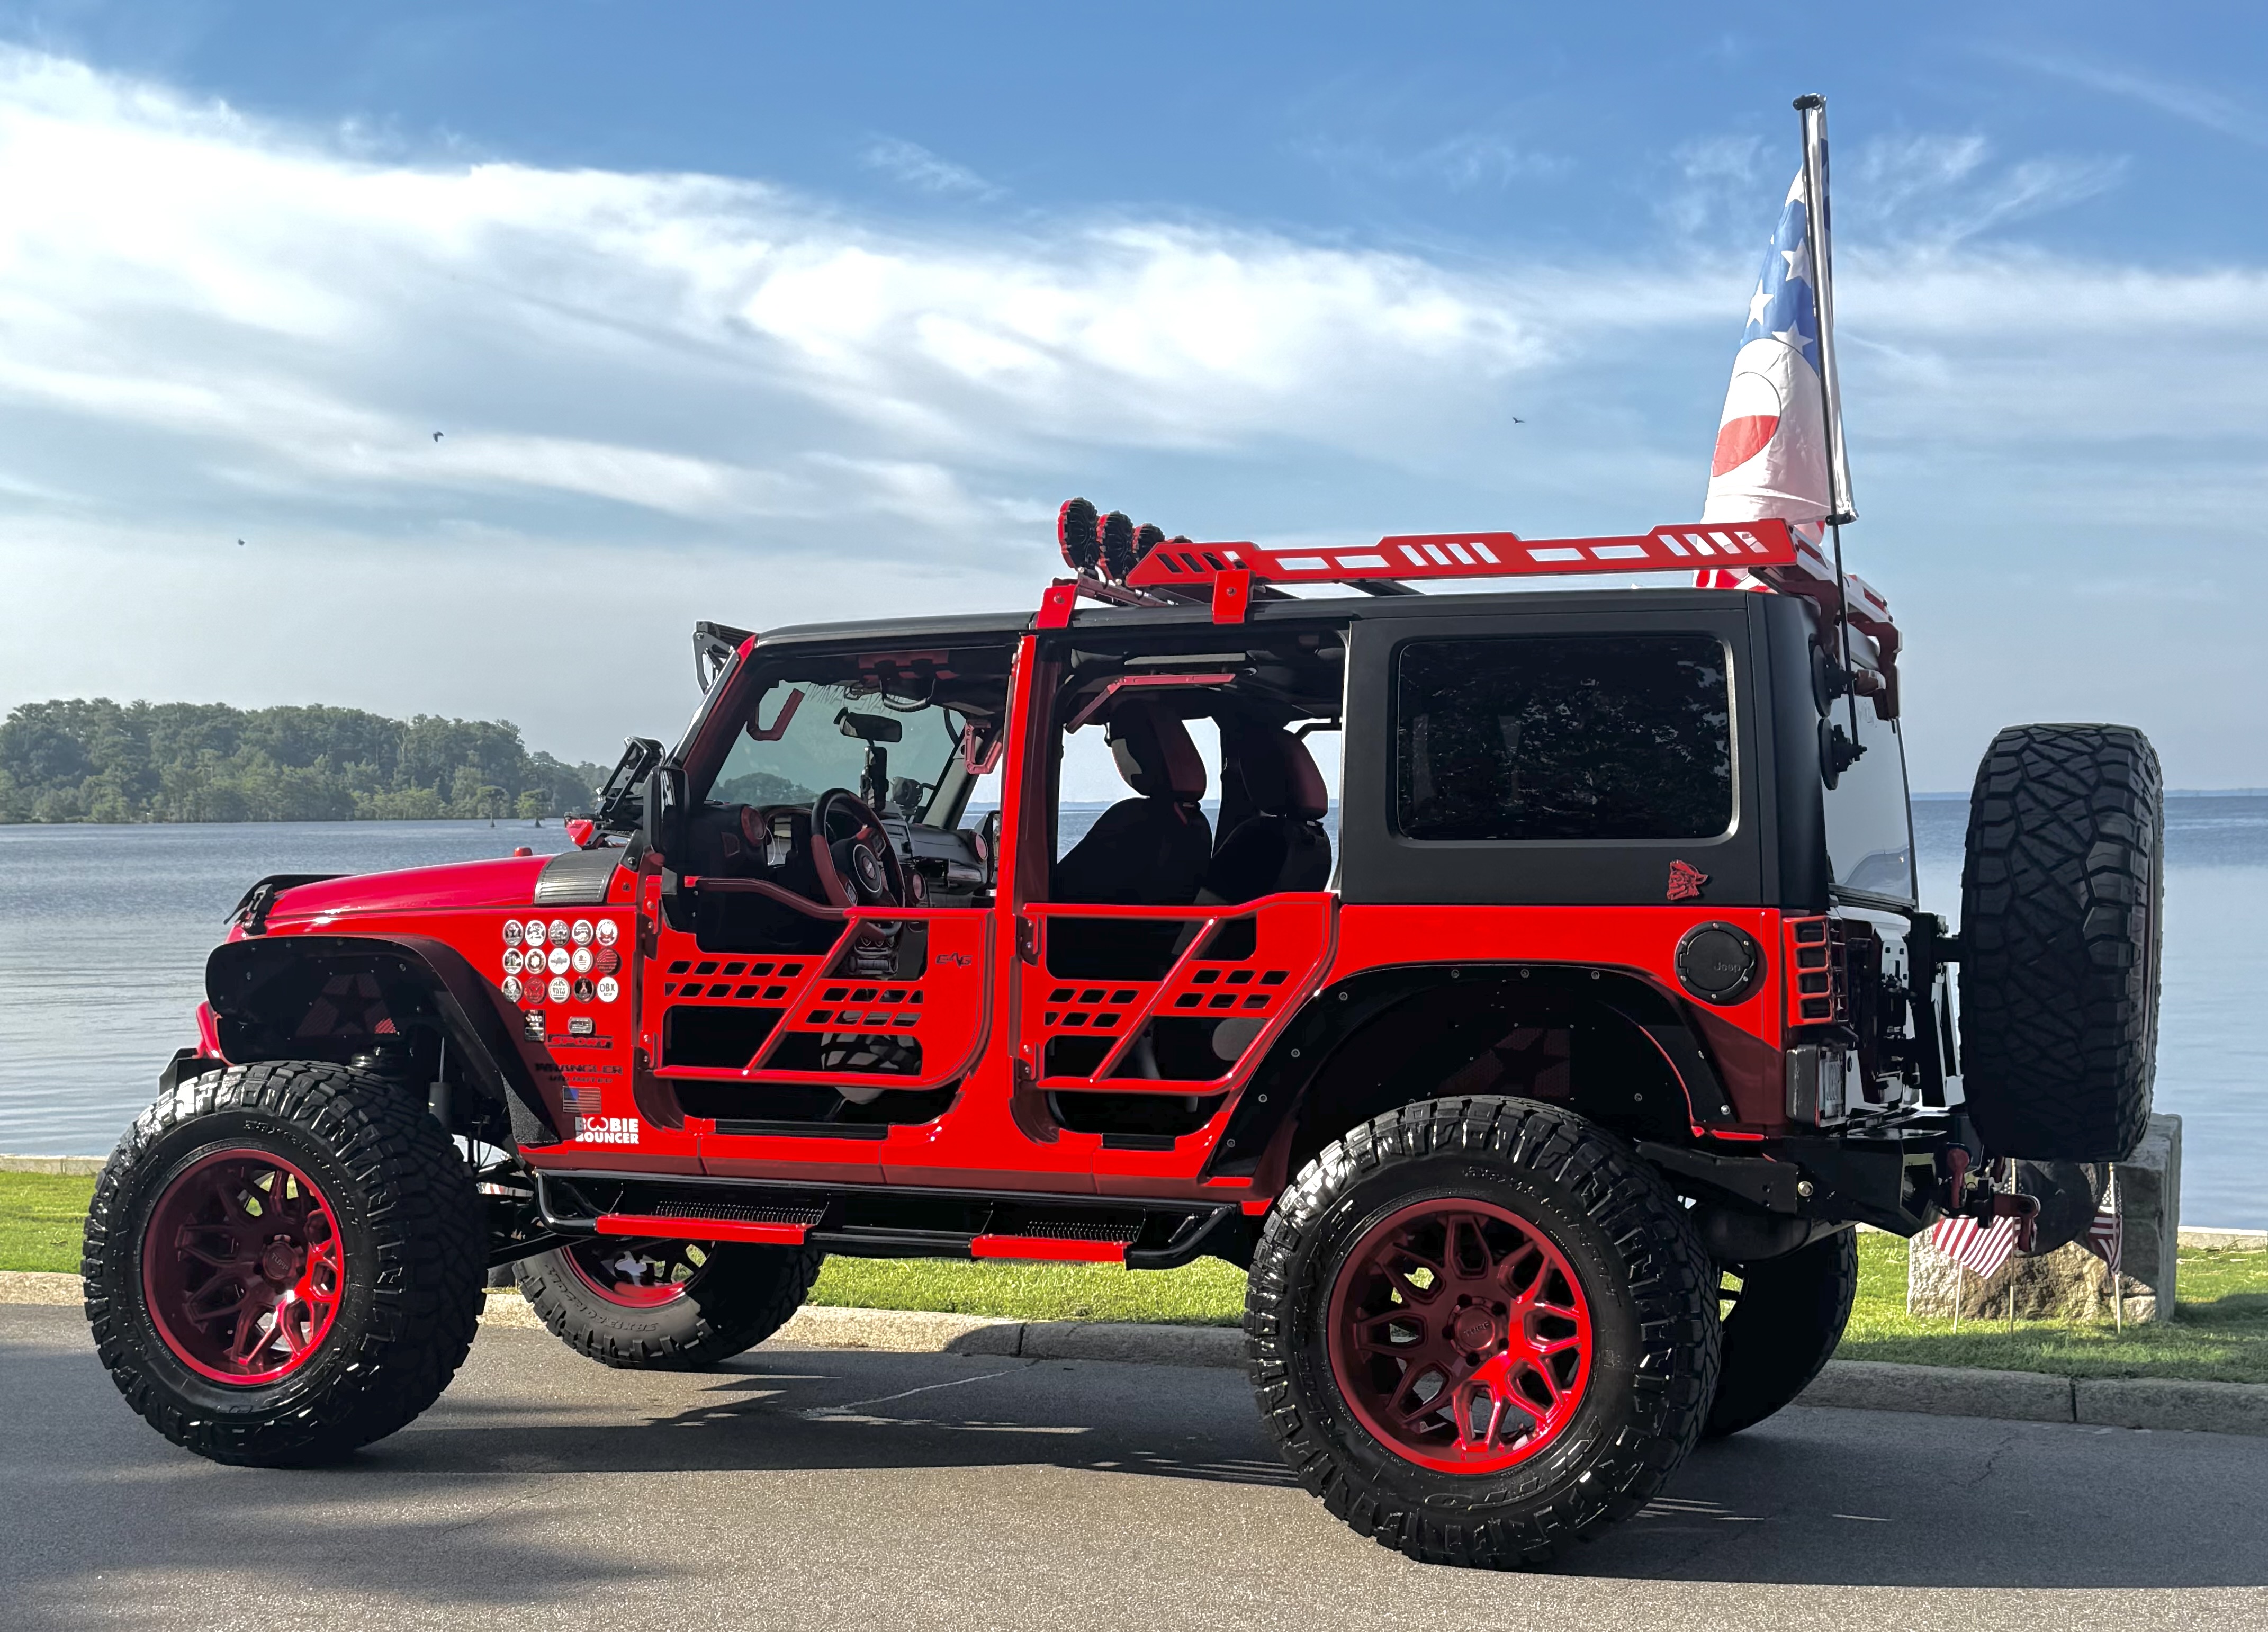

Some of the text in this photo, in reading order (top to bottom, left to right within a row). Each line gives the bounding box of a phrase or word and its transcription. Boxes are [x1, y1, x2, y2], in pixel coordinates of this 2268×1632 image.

[1714, 962, 1741, 973] Jeep
[600, 983, 615, 992] OBX
[551, 1036, 608, 1046] SPORT
[535, 1063, 624, 1075] WRANGLER
[549, 1075, 613, 1083] UNLIMITED
[575, 1131, 640, 1144] BOUNCER
